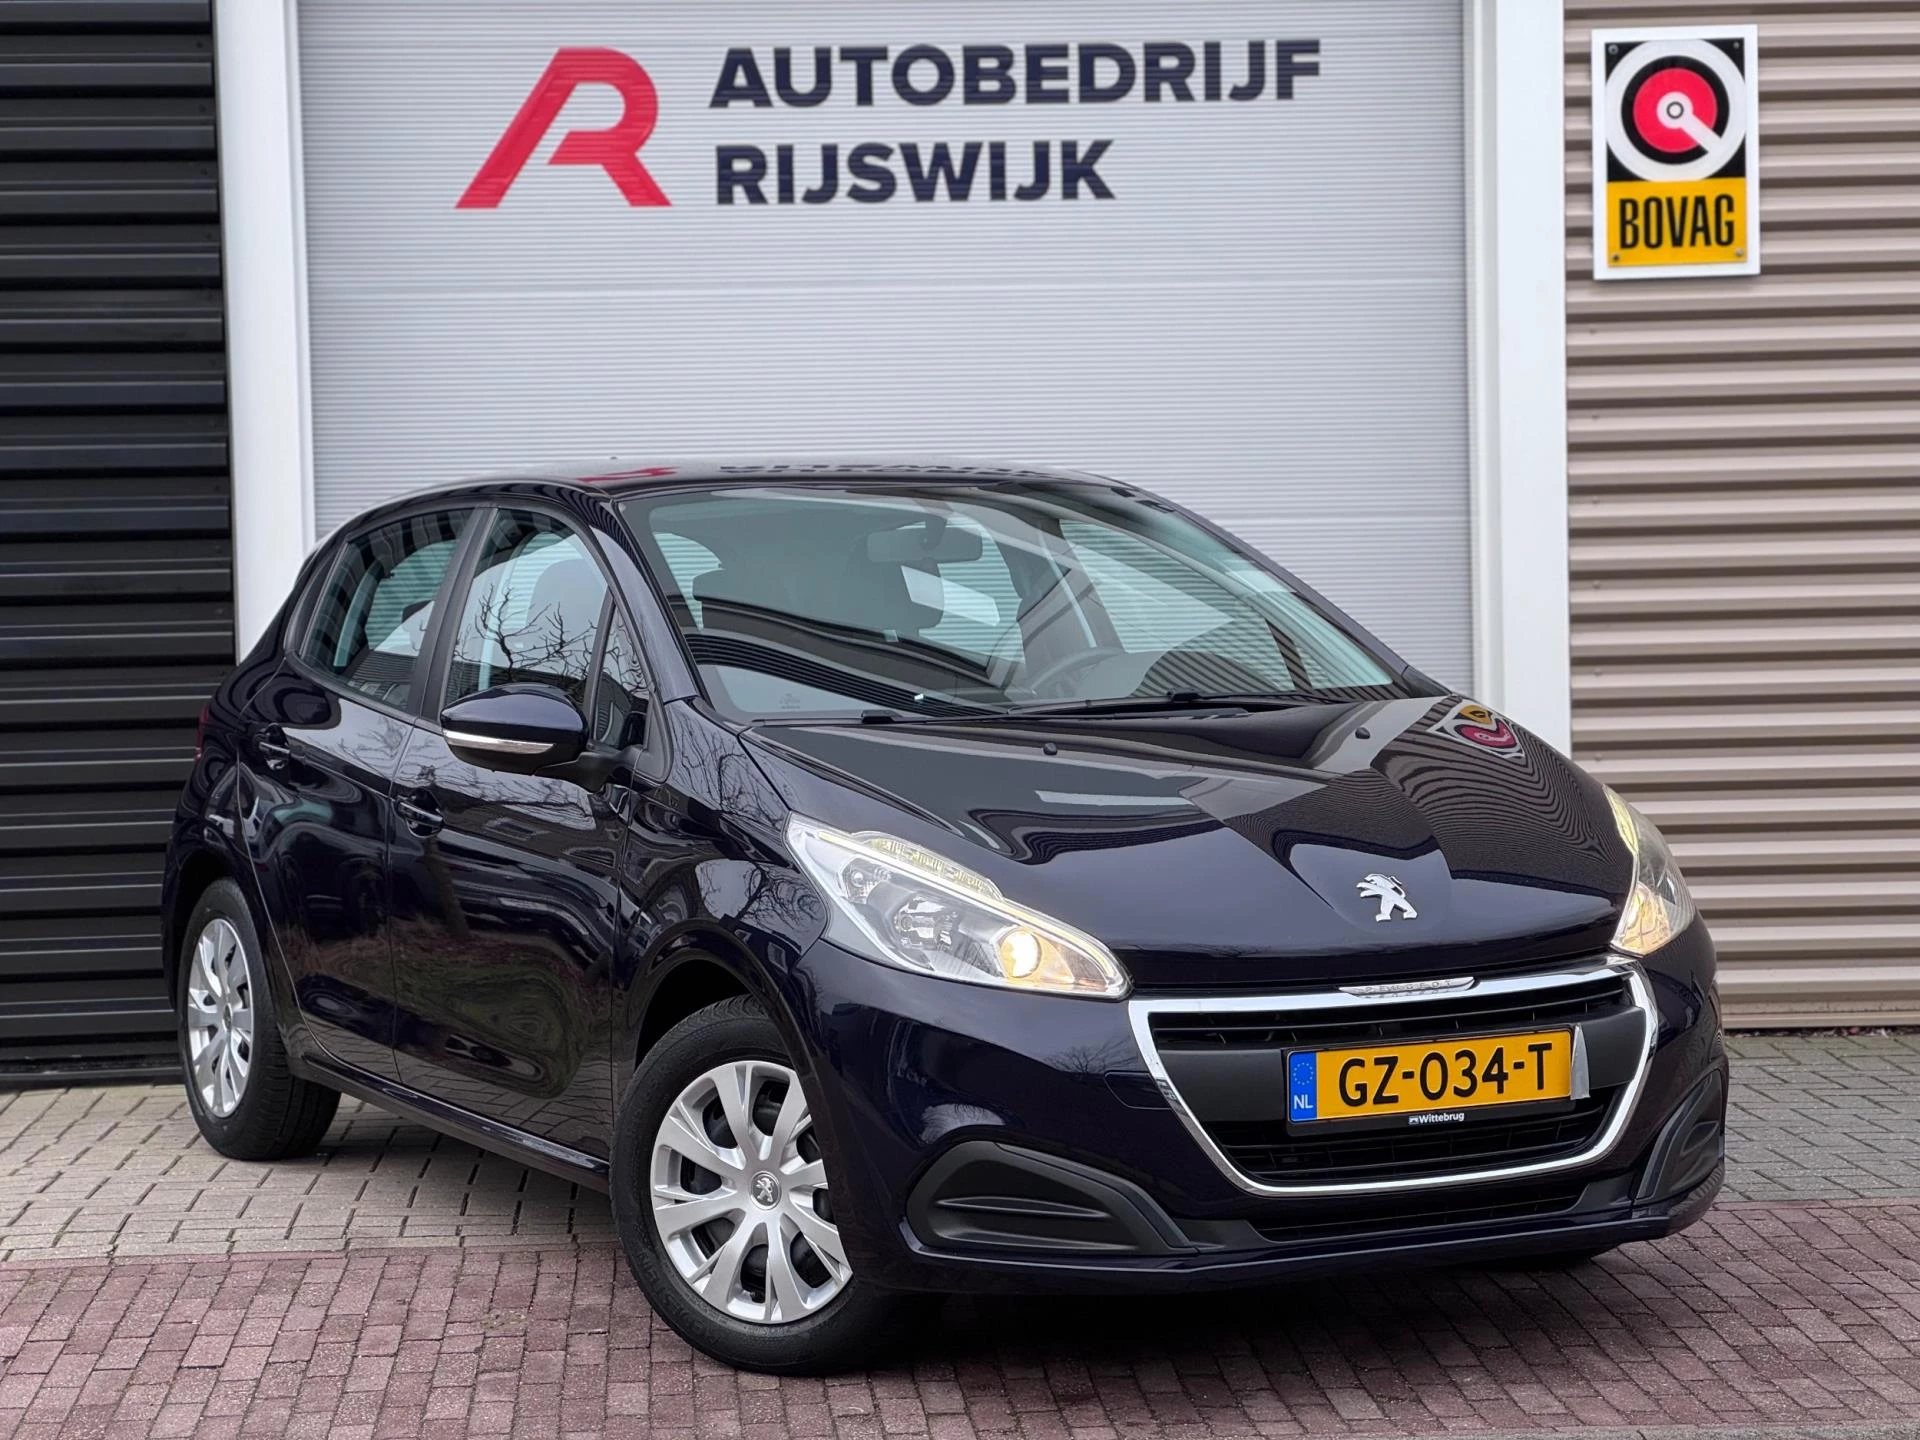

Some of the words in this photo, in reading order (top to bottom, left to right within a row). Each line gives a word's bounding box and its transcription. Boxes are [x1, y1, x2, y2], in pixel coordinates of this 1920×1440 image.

[709, 39, 1321, 108] AUTOBEDRIJF
[714, 139, 1116, 204] RIJSWIJK
[1619, 194, 1735, 249] BOVAG
[1293, 1094, 1314, 1110] NL
[1338, 1042, 1552, 1107] GZ-034-T
[1418, 1112, 1465, 1123] Wittebrug
